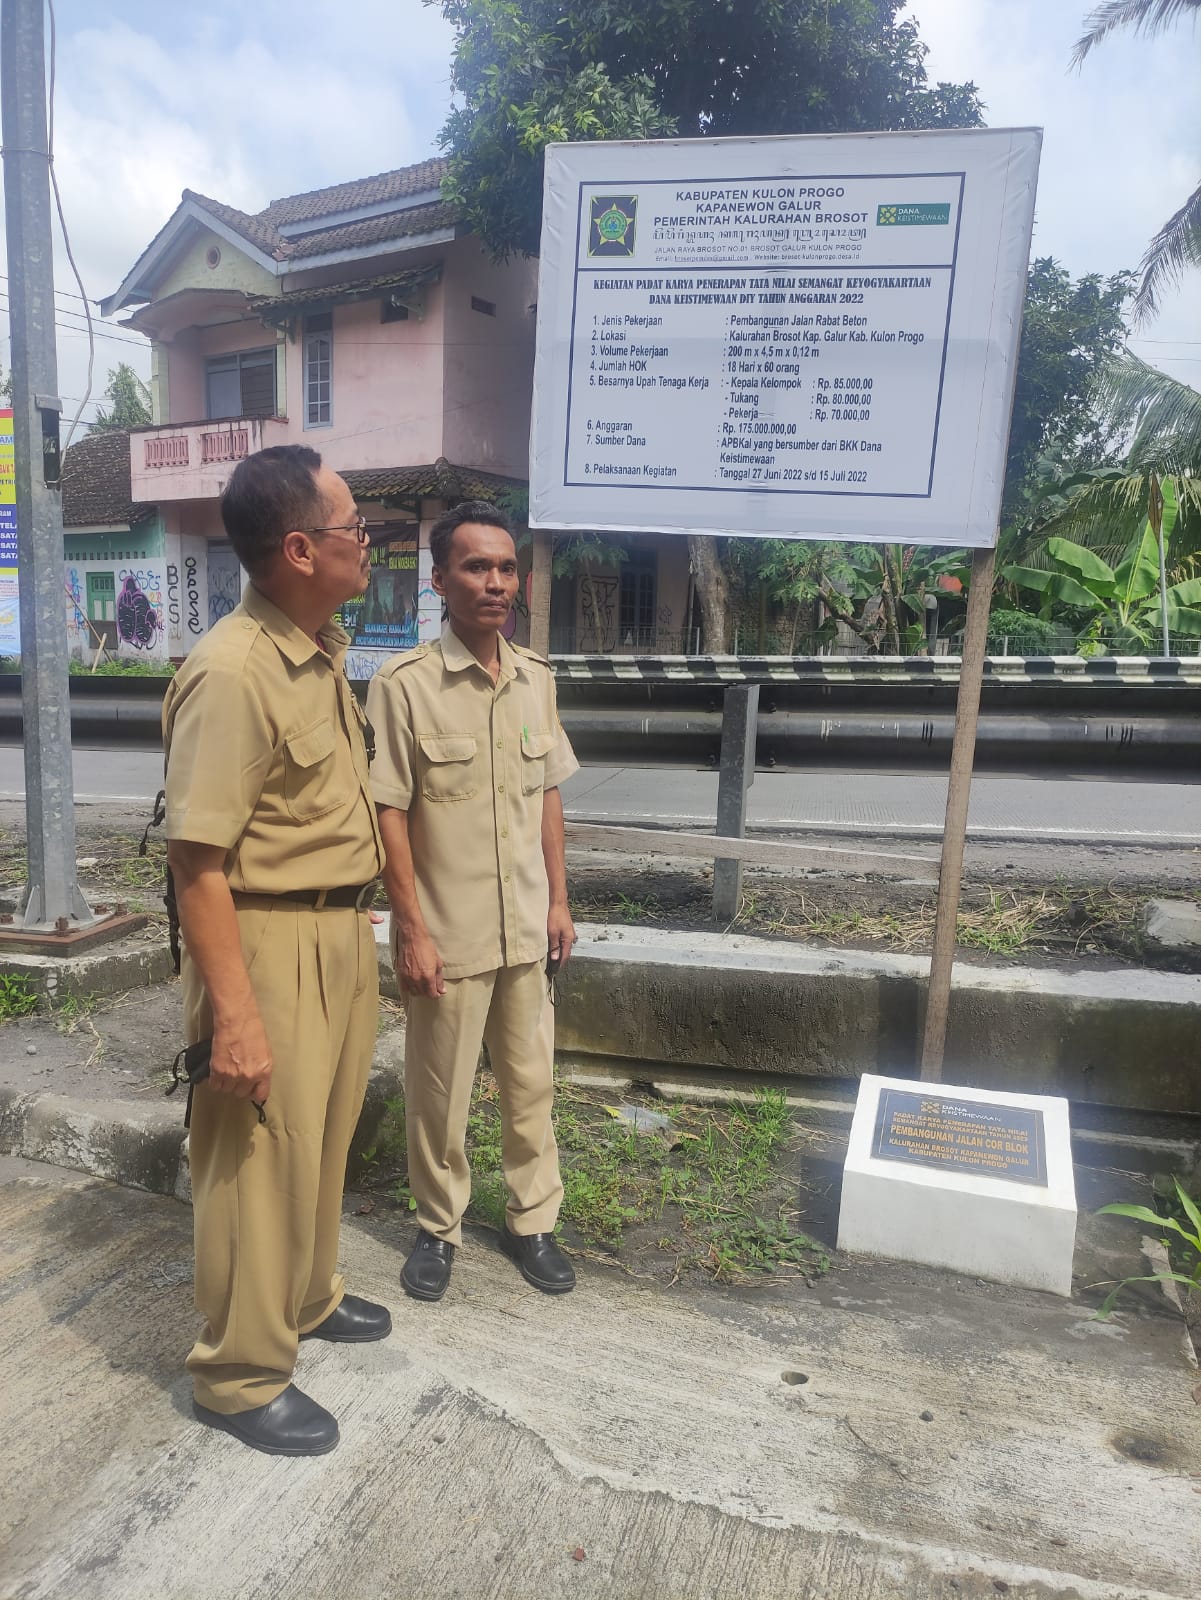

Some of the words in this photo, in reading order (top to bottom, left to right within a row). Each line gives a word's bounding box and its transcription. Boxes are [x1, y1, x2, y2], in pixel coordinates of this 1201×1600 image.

[676, 190, 748, 201] KABUPATEN
[752, 188, 795, 200] KULON
[799, 187, 845, 199] PROGO
[696, 201, 774, 213] KAPANEWON
[778, 200, 821, 212] GALUR
[654, 216, 730, 226] PEMERINTAH
[734, 214, 811, 225] KALURAHAN
[815, 213, 868, 223] BROSOT
[897, 214, 947, 222] KEISTIMEWAAN
[594, 279, 633, 289] KEGIATAN
[636, 279, 663, 289] PADAT
[666, 279, 693, 289] KARYA
[696, 279, 746, 289] PENERAPAN
[749, 278, 769, 288] TATA
[772, 278, 796, 288] NILAI
[798, 277, 843, 288] SEMANGAT
[846, 277, 931, 288] KEYOGYAKARTAAN
[649, 294, 671, 304] DANA
[674, 294, 737, 304] KEISTIMEWAAN
[739, 294, 755, 304] DIY
[758, 293, 786, 304] TAHUN
[788, 293, 837, 304] ANGGARAN
[839, 293, 864, 304] 2022
[593, 315, 599, 326] 1.
[601, 315, 622, 326] Jenis
[624, 316, 662, 328] Pekerjaan
[731, 315, 789, 328] Pembangunan
[791, 315, 813, 326] Jalan
[815, 315, 840, 326] Rabat
[842, 315, 867, 326] Beton
[592, 331, 598, 341] 2.
[601, 330, 626, 341] Lokasi
[729, 330, 770, 341] Kalurahan
[773, 331, 801, 342] Brosot
[803, 331, 821, 344] Kap.
[824, 331, 847, 342] Galur
[850, 331, 868, 342] Kab.
[871, 331, 896, 342] Kulon
[898, 331, 924, 344] Progo
[591, 346, 597, 356] 3.
[600, 345, 628, 356] Volume
[630, 345, 669, 358] Pekerjaan
[728, 346, 742, 357] 200
[744, 348, 753, 357] m
[761, 346, 773, 358] 4,5
[775, 349, 783, 357] m
[792, 346, 809, 358] 0,12
[811, 349, 819, 357] m
[590, 361, 597, 371] 4.
[599, 360, 627, 371] Jumlah
[629, 361, 647, 371] HOK
[727, 361, 737, 372] 18
[739, 361, 755, 372] Hari
[764, 362, 774, 372] 60
[776, 364, 800, 375] orang
[590, 376, 596, 386] 5.
[598, 375, 634, 388] Besarnya
[636, 376, 656, 389] Upah
[659, 376, 686, 389] Tenaga
[688, 376, 709, 389] Kerja
[731, 377, 758, 390] Kepala
[761, 377, 801, 391] Kelompok
[818, 378, 831, 390] Rp.
[834, 378, 873, 391] 85.000,00
[730, 392, 759, 405] Tukang
[817, 394, 830, 406] Rp.
[832, 394, 871, 406] 80.000,00
[729, 408, 759, 421] Pekerja
[815, 409, 828, 422] Rp.
[832, 409, 870, 421] 70.000,00
[587, 420, 594, 430] 6.
[595, 420, 632, 433] Anggaran
[723, 423, 736, 436] Rp.
[738, 423, 797, 435] 175.000.000,00
[587, 435, 593, 445] 7.
[595, 435, 624, 446] Sumber
[626, 436, 646, 446] Dana
[721, 437, 752, 449] APBKal
[753, 441, 773, 451] yang
[776, 439, 819, 450] bersumber
[821, 440, 837, 450] dari
[840, 440, 858, 451] BKK
[861, 441, 882, 452] Dana
[720, 452, 775, 464] Keistimewaan
[585, 464, 592, 474] 8.
[593, 464, 641, 475] Pelaksanaan
[643, 465, 677, 478] Kegiatan
[719, 467, 750, 480] Tanggal
[753, 468, 762, 479] 27
[764, 468, 781, 479] Juni
[784, 469, 802, 480] 2022
[805, 469, 817, 480] s/d
[820, 470, 829, 481] 15
[831, 470, 846, 481] Juli
[848, 471, 867, 482] 2022
[942, 1104, 967, 1112] DANA
[890, 1125, 954, 1142] PEMBANGUNAN
[956, 1134, 983, 1147] JALAN
[985, 1139, 1003, 1150] COR
[1005, 1142, 1029, 1155] BLOK
